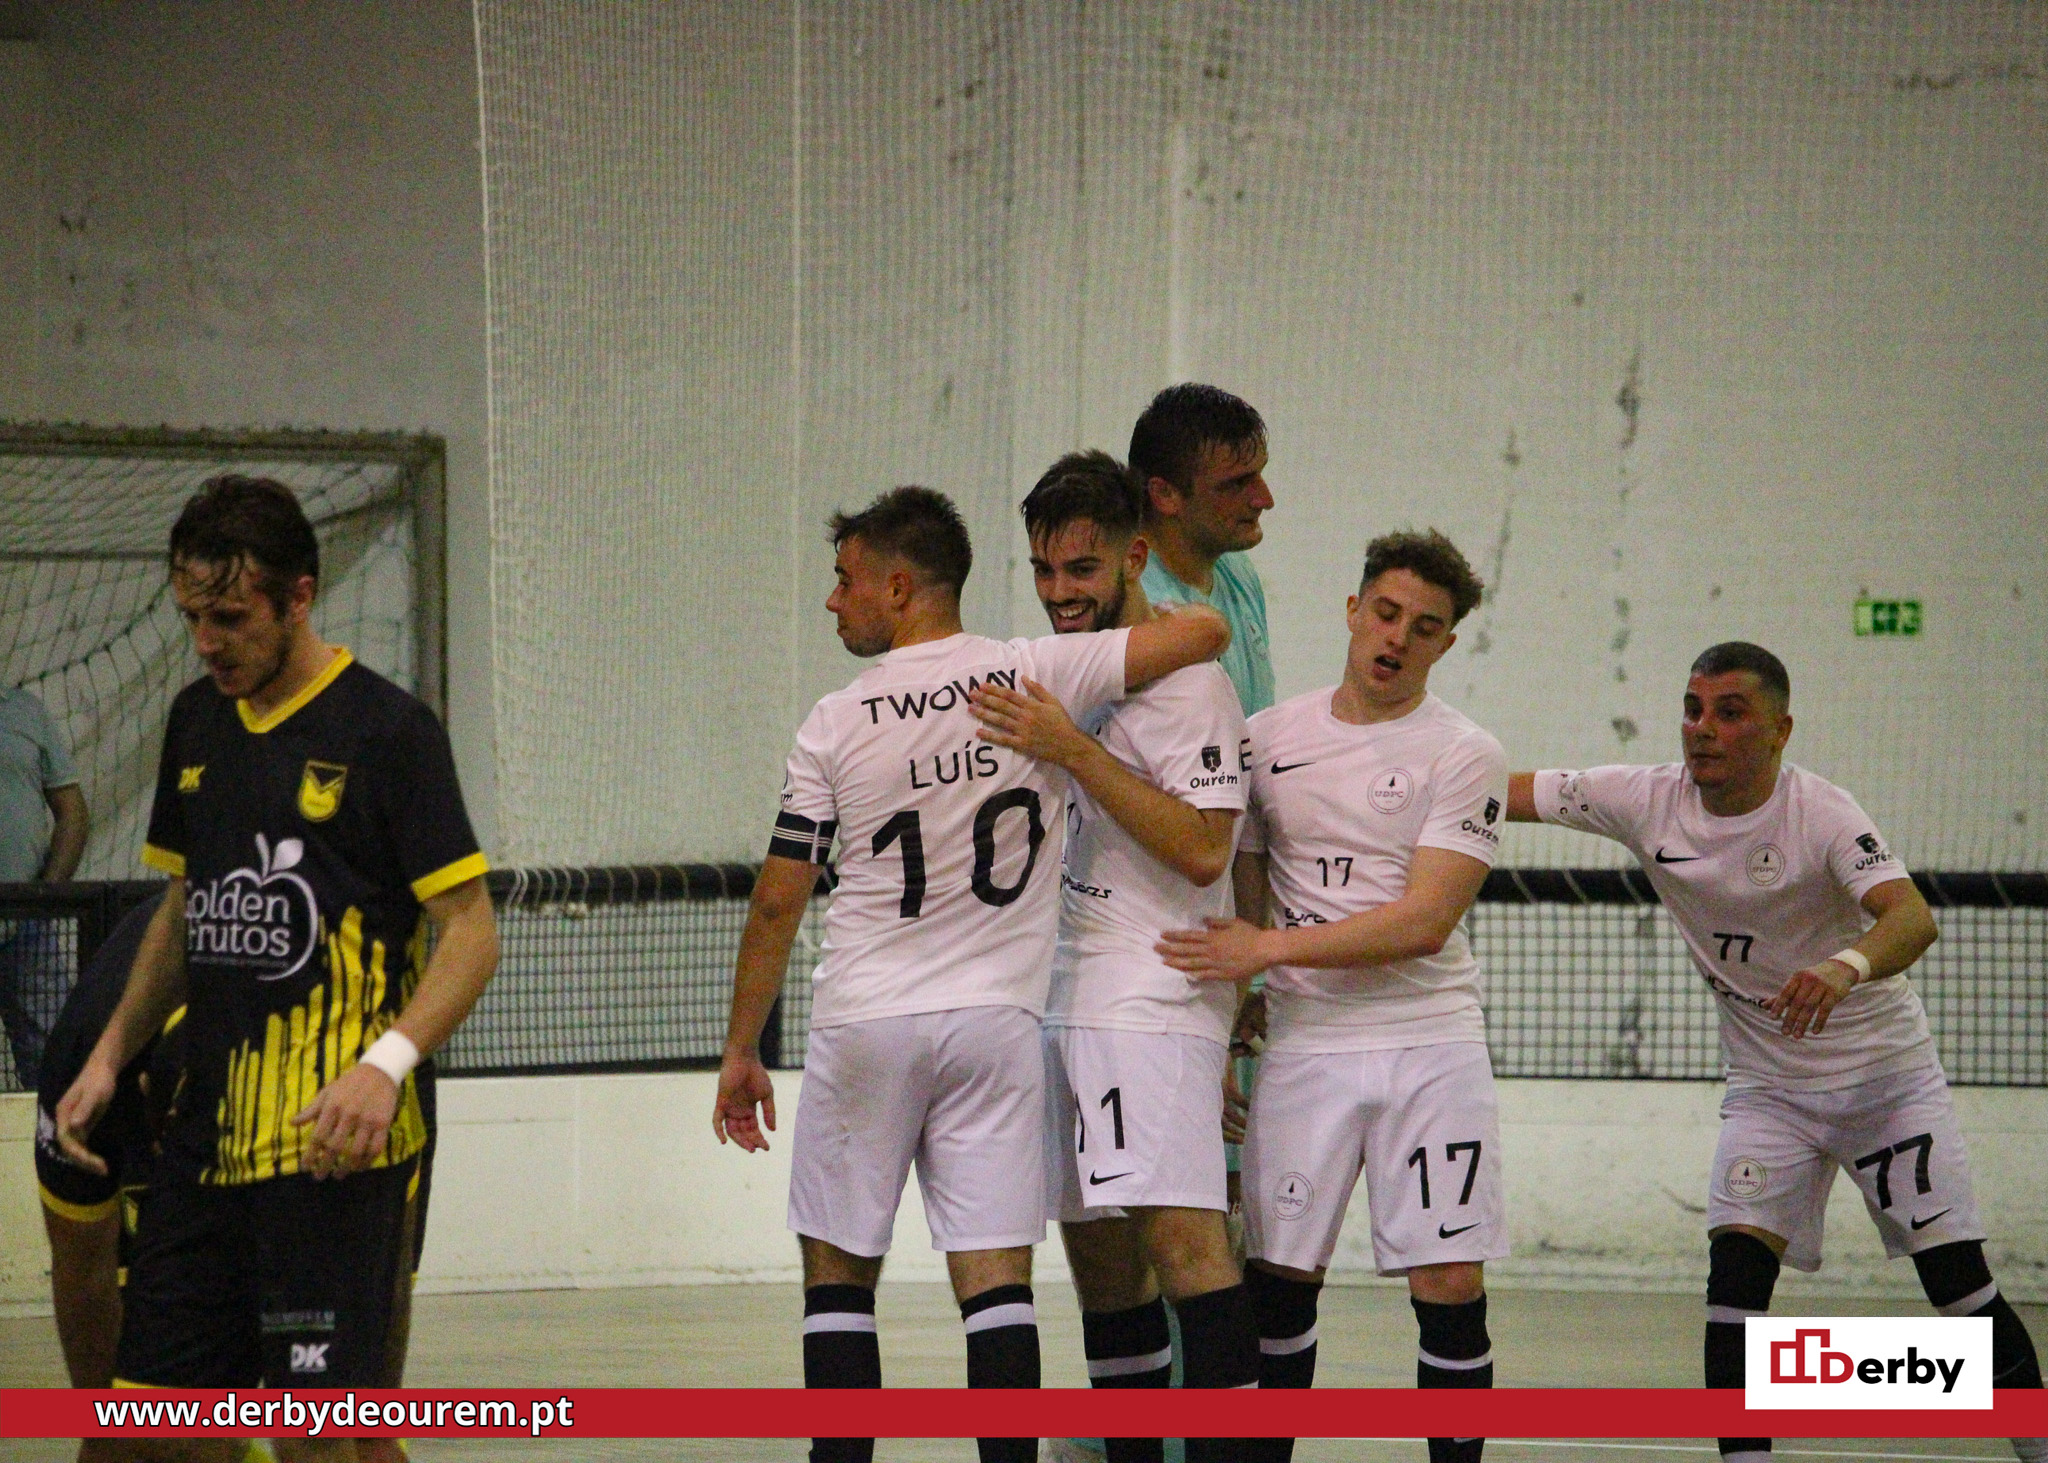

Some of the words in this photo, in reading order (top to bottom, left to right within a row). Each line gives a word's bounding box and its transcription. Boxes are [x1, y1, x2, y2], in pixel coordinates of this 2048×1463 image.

[910, 740, 999, 790] LUÍS
[1190, 771, 1238, 789] Ourém
[871, 787, 1046, 918] 10
[1316, 857, 1354, 888] 17
[184, 879, 291, 923] olden
[1713, 932, 1755, 963] 77
[1408, 1140, 1482, 1210] 17
[1854, 1132, 1934, 1211] 77
[290, 1343, 330, 1373] DK
